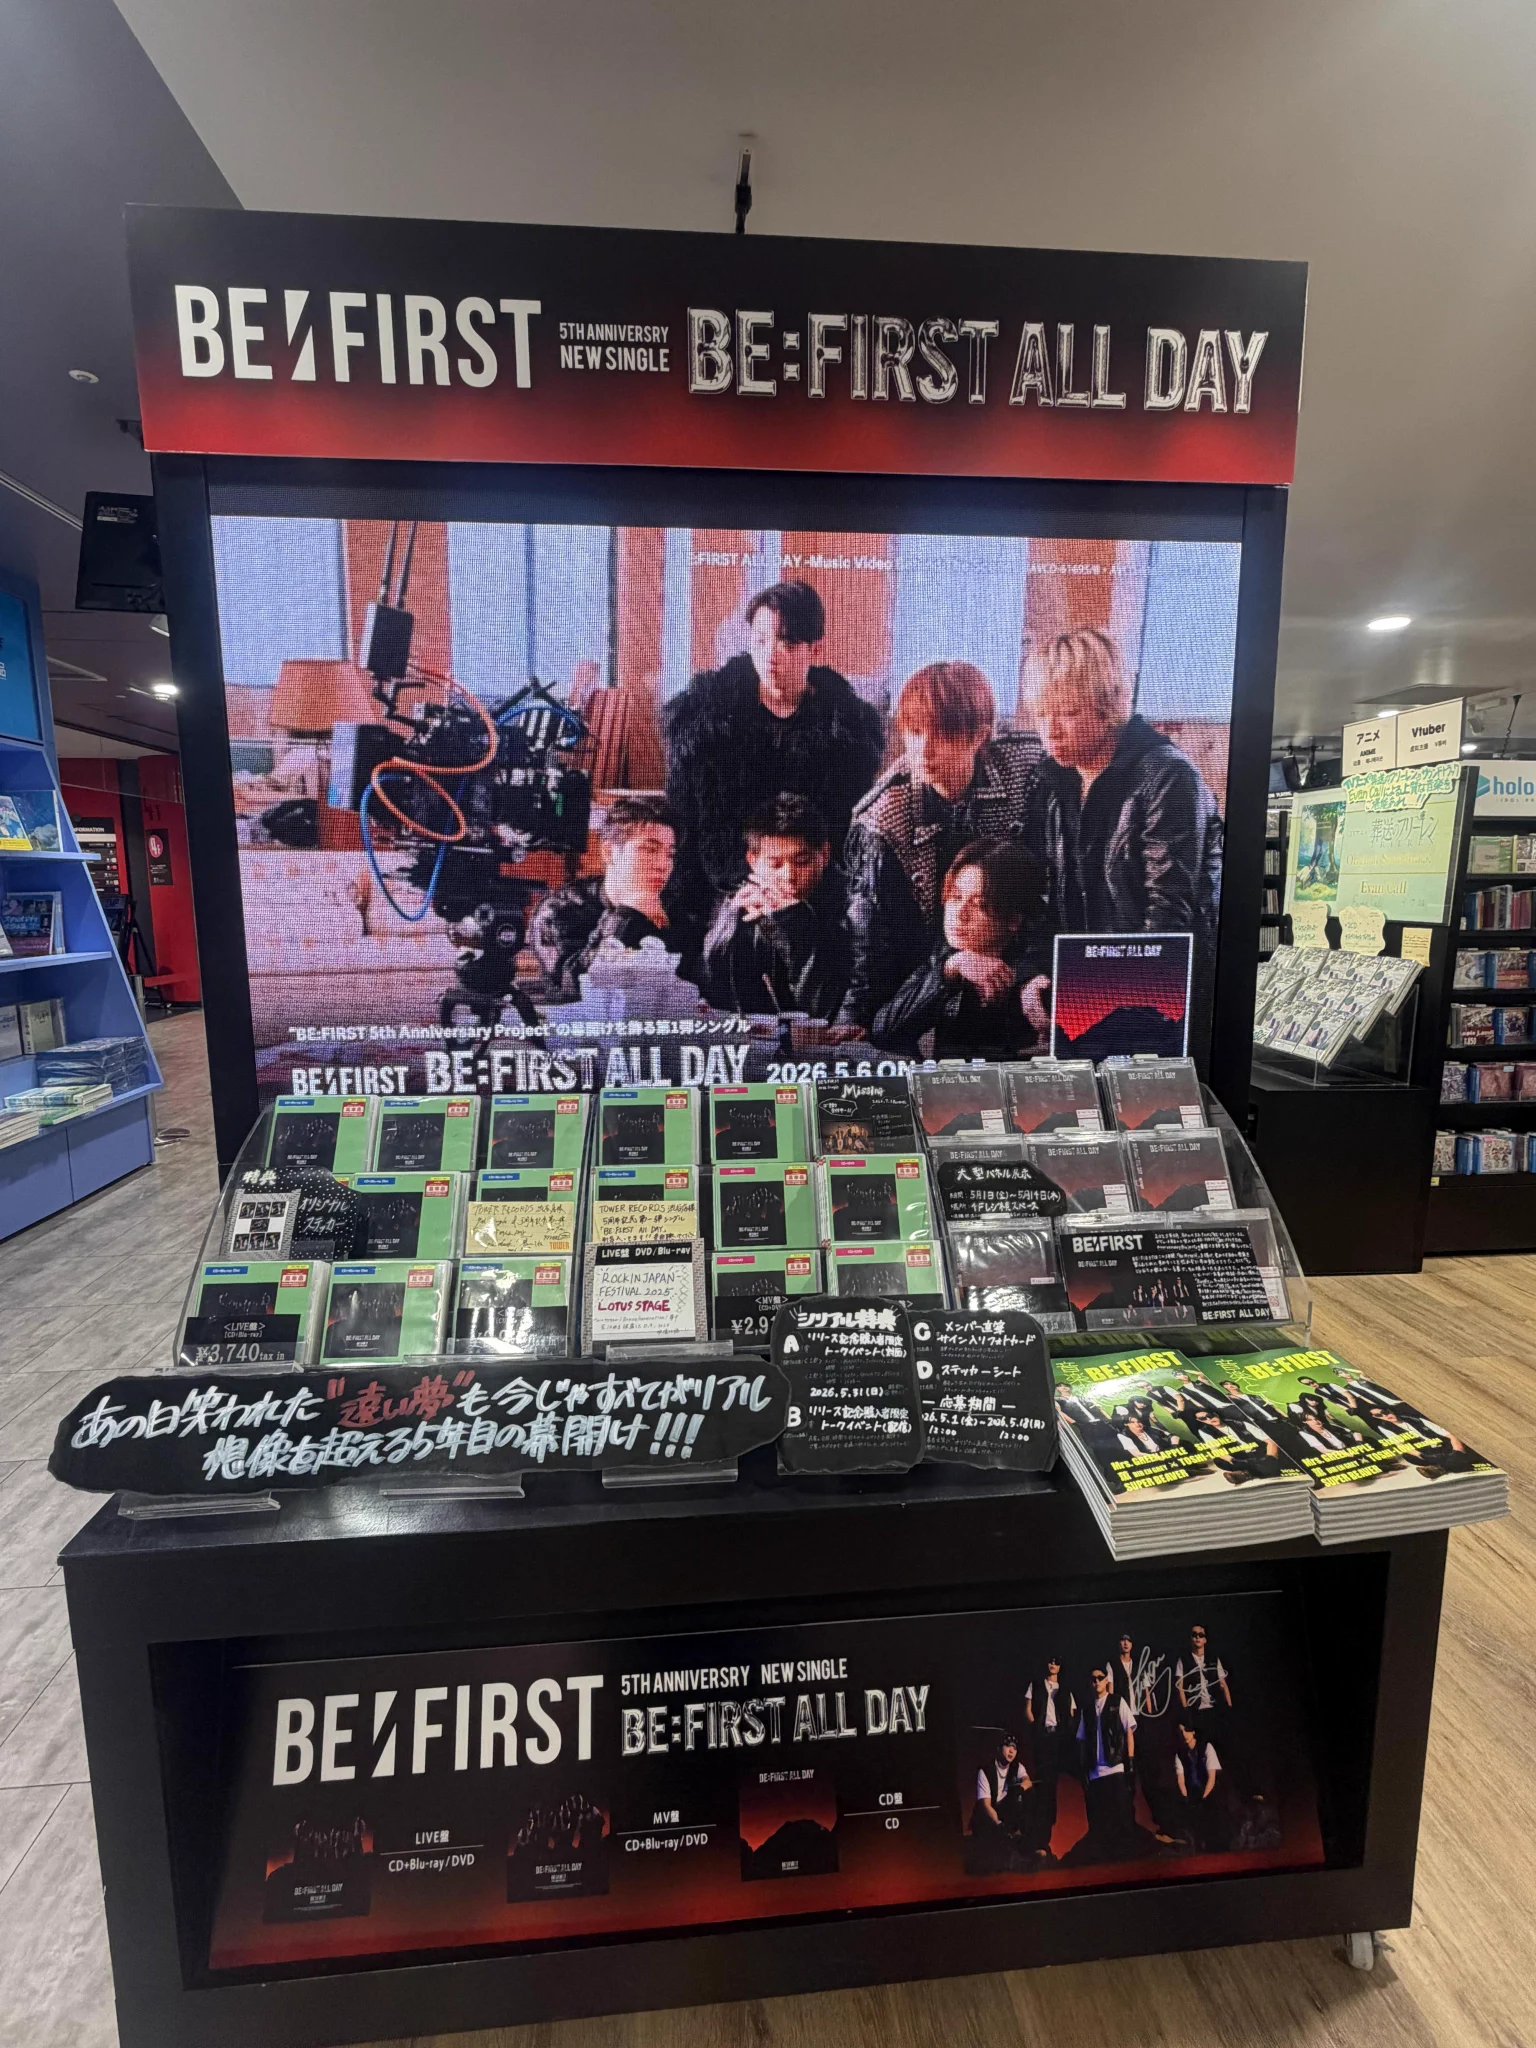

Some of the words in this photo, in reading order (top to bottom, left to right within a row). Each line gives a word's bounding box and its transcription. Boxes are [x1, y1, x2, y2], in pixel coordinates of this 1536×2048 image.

[559, 322, 586, 341] 5TH
[560, 345, 602, 370] NEW
[606, 348, 670, 372] SINGLE
[688, 307, 999, 405] BE:FIRST
[1010, 322, 1126, 409] ALL
[1145, 326, 1269, 414] DAY
[1356, 730, 1380, 745] アニメ
[1412, 724, 1446, 738] Vtuber
[1361, 881, 1384, 894] Evan
[425, 1047, 598, 1094] BE:FIRST
[604, 1046, 672, 1088] ALL
[680, 1044, 752, 1087] DAY
[243, 1170, 277, 1186] 特典
[300, 1197, 350, 1213] オリジナル
[599, 1204, 626, 1213] TOWER
[628, 1203, 666, 1213] RECORDS
[304, 1216, 348, 1233] ステッカー
[549, 1241, 570, 1250] TOWER
[642, 1272, 675, 1284] JAPAN
[599, 1286, 641, 1297] FESTIVAL
[644, 1287, 674, 1297] 2025
[598, 1300, 633, 1312] LOTUS
[634, 1299, 671, 1312] STAGE
[1239, 1308, 1255, 1318] ALL
[1254, 1307, 1271, 1316] DAY
[731, 1315, 776, 1336] ¥2,9
[783, 1334, 800, 1353] A
[260, 1351, 273, 1361] tax
[275, 1350, 285, 1361] in
[916, 1360, 933, 1380] D
[1084, 1351, 1183, 1382] BE:FIRST
[1244, 1350, 1340, 1380] BE:FIRST
[787, 1406, 801, 1428] B
[928, 1425, 957, 1436] 12:00
[999, 1430, 1030, 1442] 12:00
[1110, 1459, 1133, 1471] Mrs.
[1301, 1456, 1325, 1468] Mrs.
[1123, 1477, 1157, 1492] SUPER
[1155, 1469, 1189, 1485] BEAVER
[1320, 1474, 1351, 1488] SUPER
[1349, 1465, 1383, 1481] BEAVER
[621, 1673, 650, 1696] 5TH
[653, 1665, 750, 1693] ANNIVERSRY
[761, 1662, 795, 1685] NEW
[797, 1658, 848, 1682] SINGLE
[621, 1695, 786, 1757] BE:FIRST
[793, 1691, 858, 1743] ALL
[864, 1684, 931, 1736] DAY
[801, 1769, 815, 1780] DAY
[652, 1810, 680, 1825] MV盤
[884, 1817, 900, 1830] CD
[415, 1829, 450, 1845] LIVE盤
